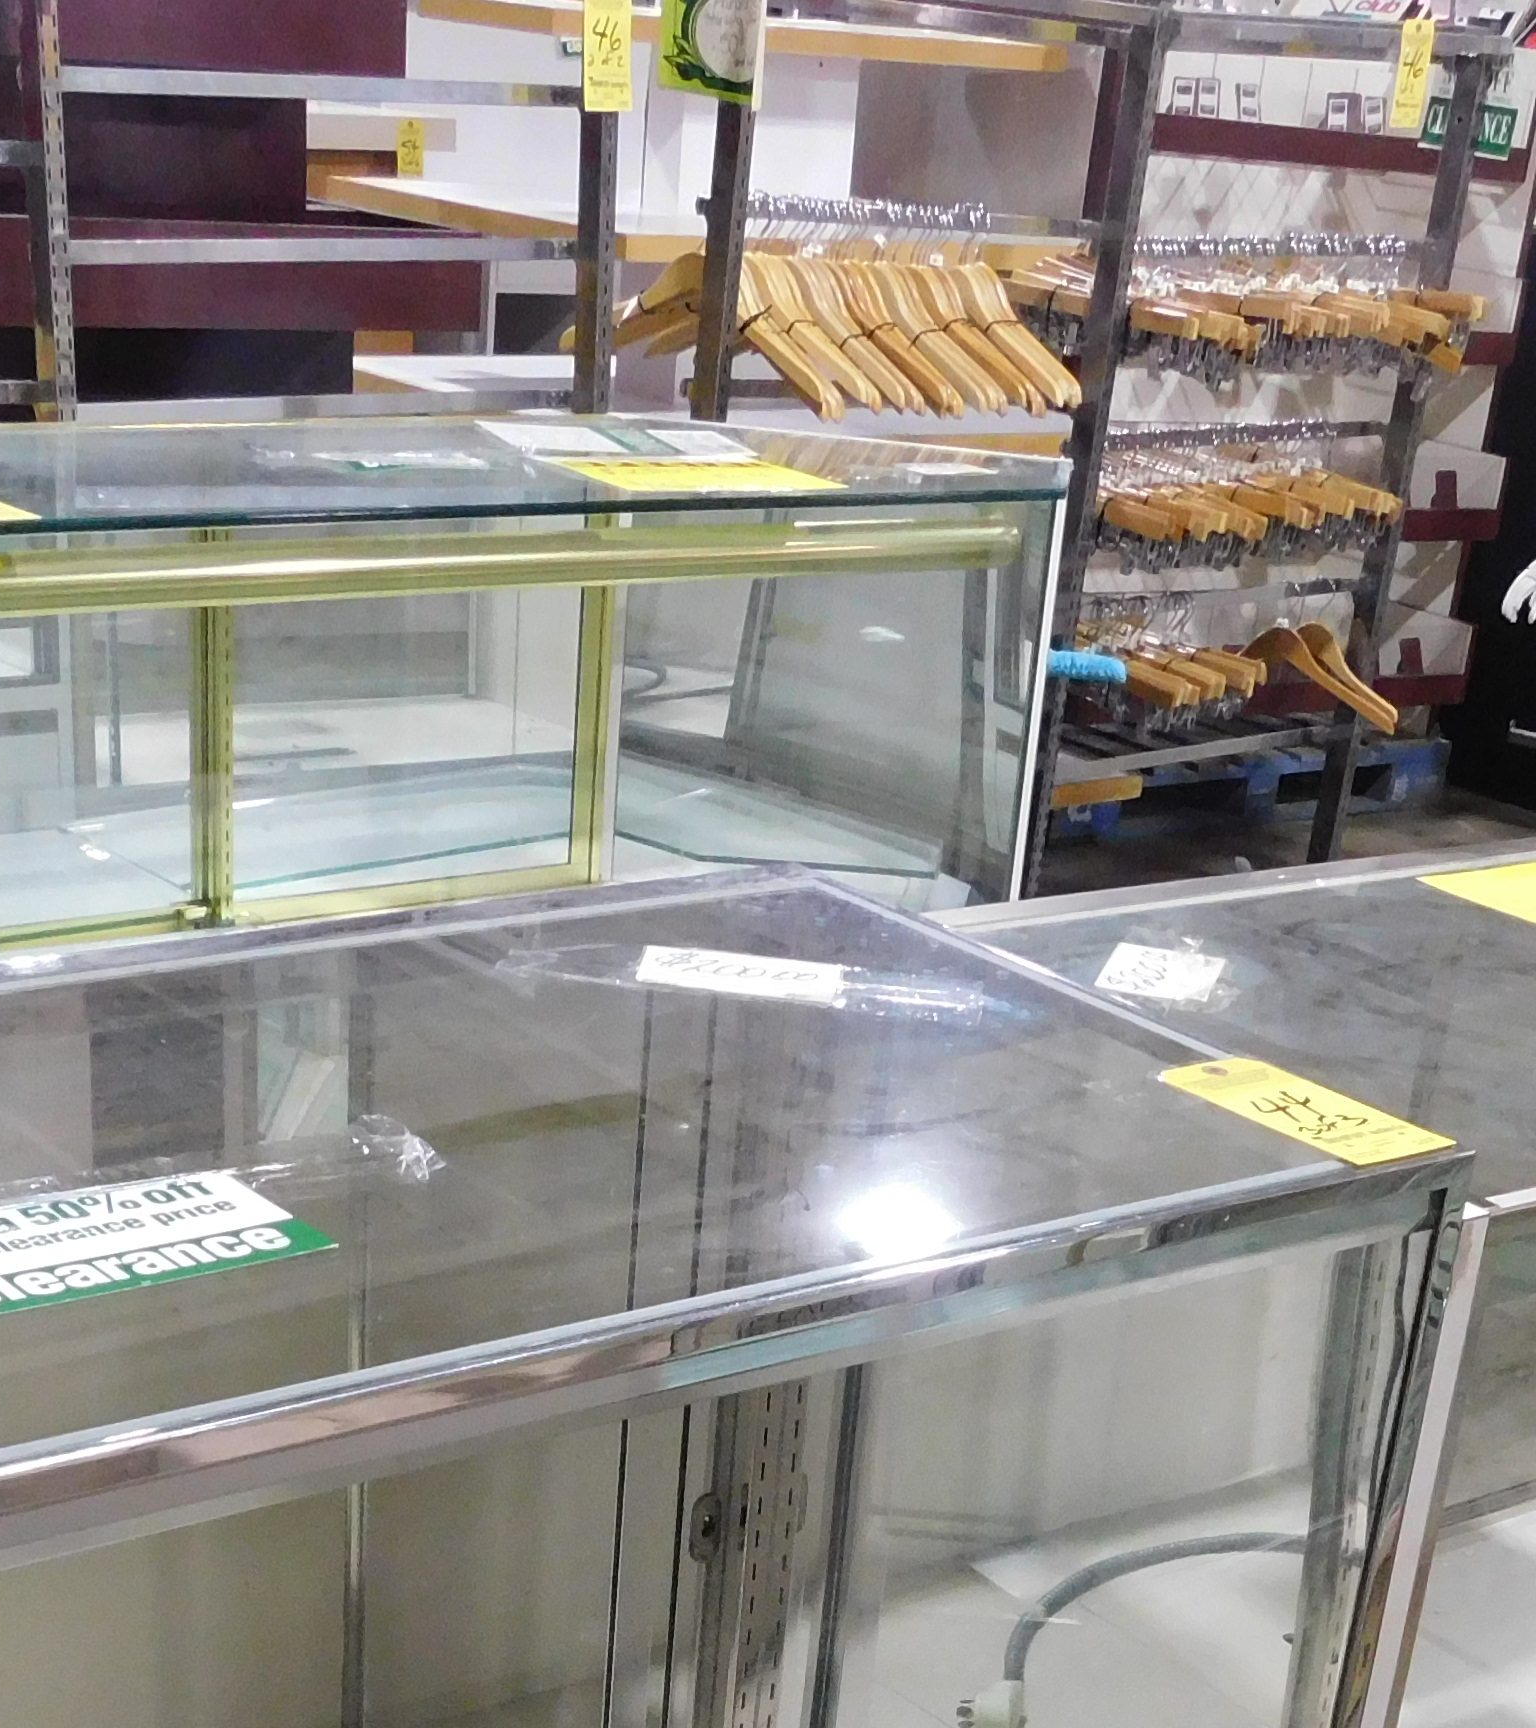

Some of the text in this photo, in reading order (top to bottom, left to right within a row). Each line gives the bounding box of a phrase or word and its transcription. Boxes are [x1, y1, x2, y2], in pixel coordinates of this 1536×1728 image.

[592, 15, 622, 52] 46
[17, 1191, 142, 1226] 50%
[140, 1179, 214, 1205] off
[150, 1200, 238, 1227] price
